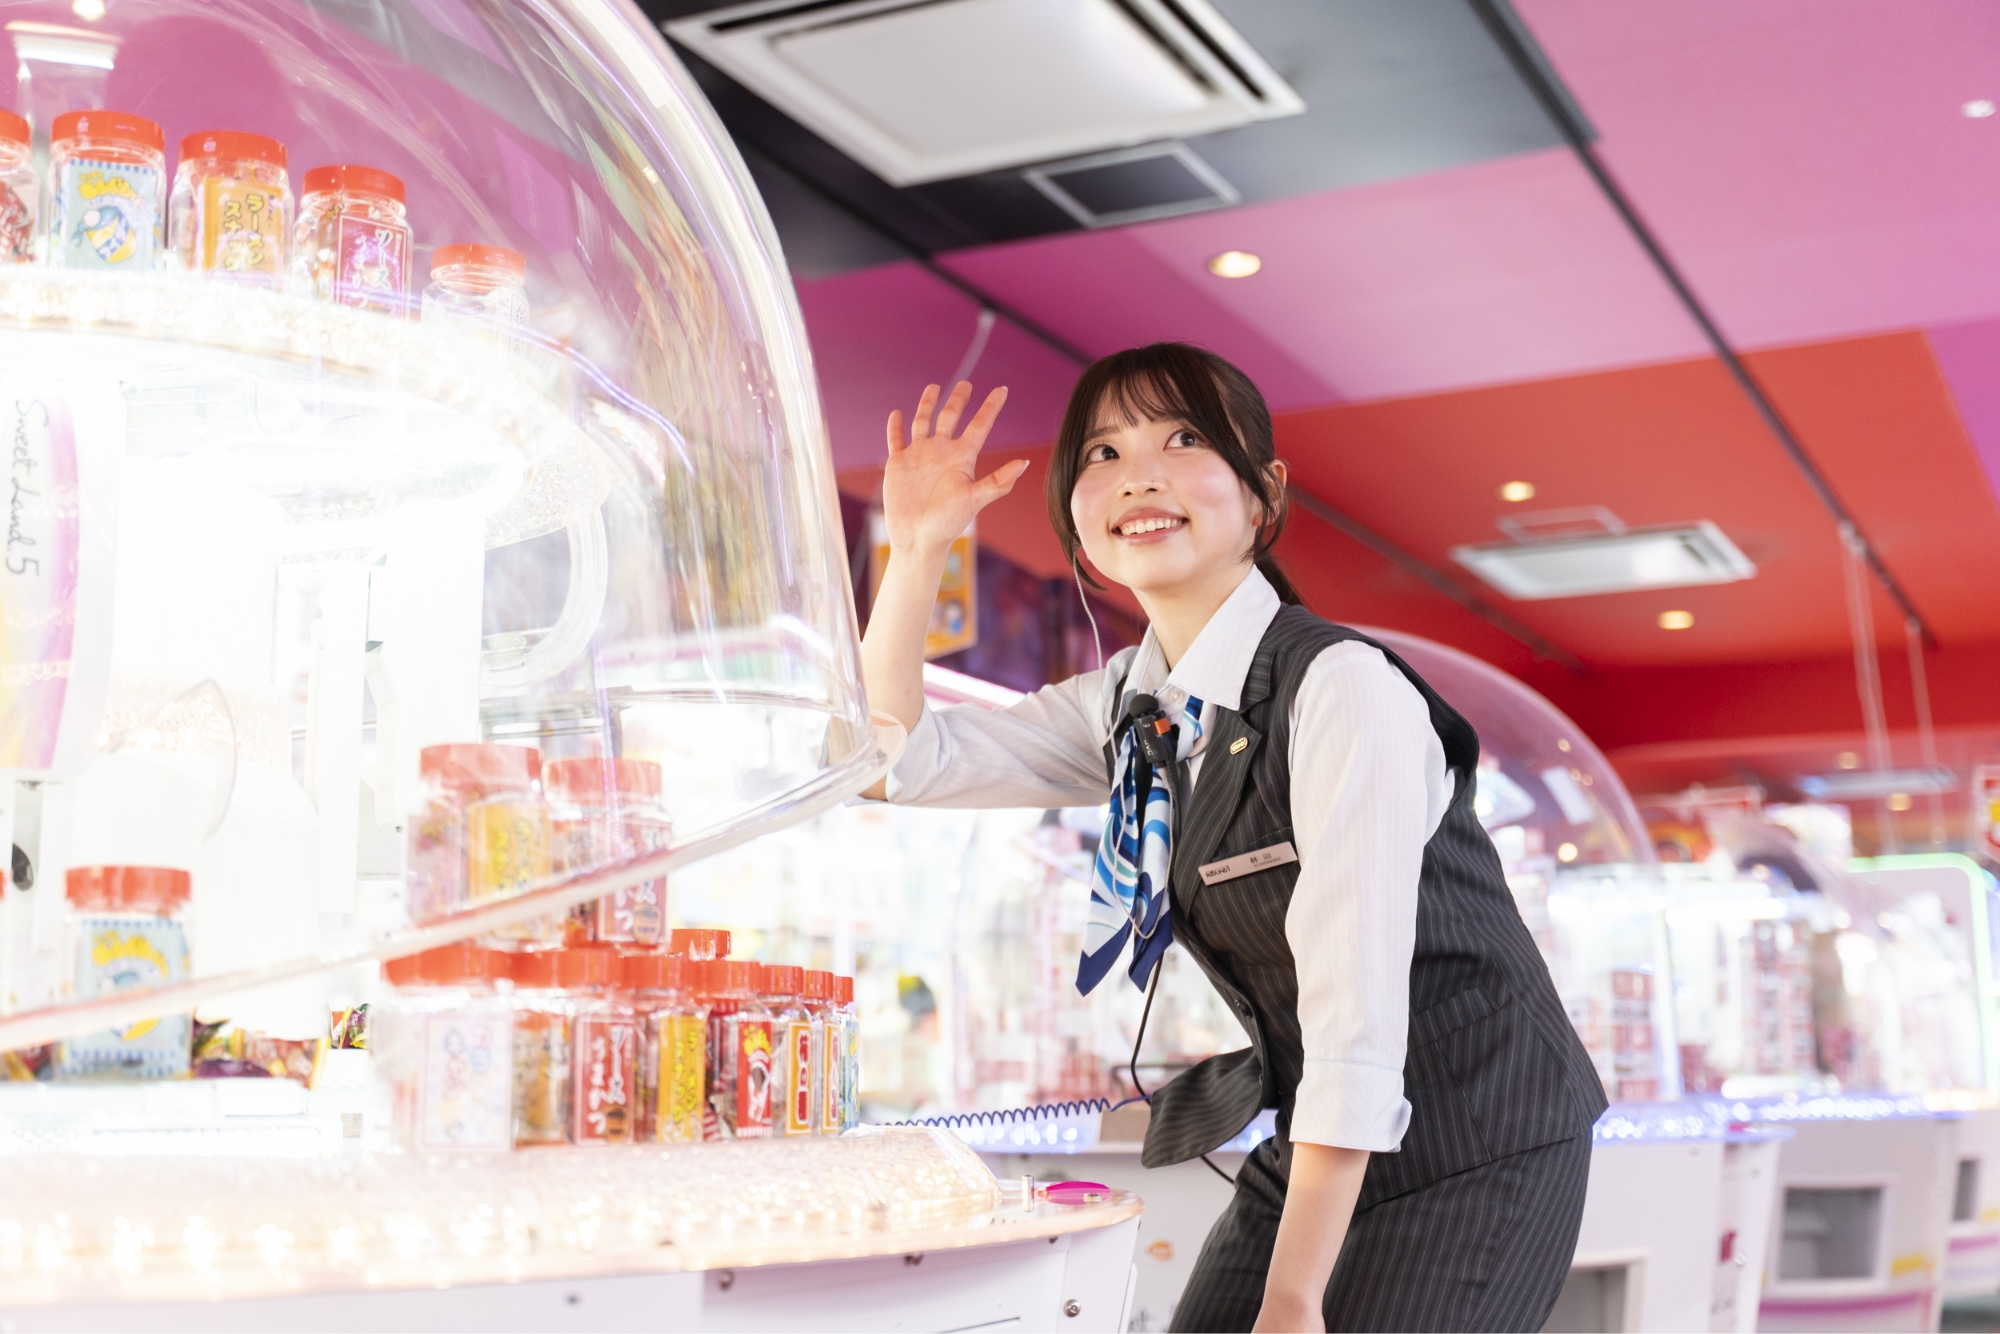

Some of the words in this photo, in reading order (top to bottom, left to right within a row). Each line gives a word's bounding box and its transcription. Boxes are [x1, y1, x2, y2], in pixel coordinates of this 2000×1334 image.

[222, 200, 243, 272] スナック
[245, 193, 265, 266] ラーメン
[375, 228, 393, 291] ソース
[13, 399, 49, 475] Sweet
[8, 477, 41, 550] Land
[5, 556, 40, 577] 5
[1205, 865, 1231, 878] ROUND1
